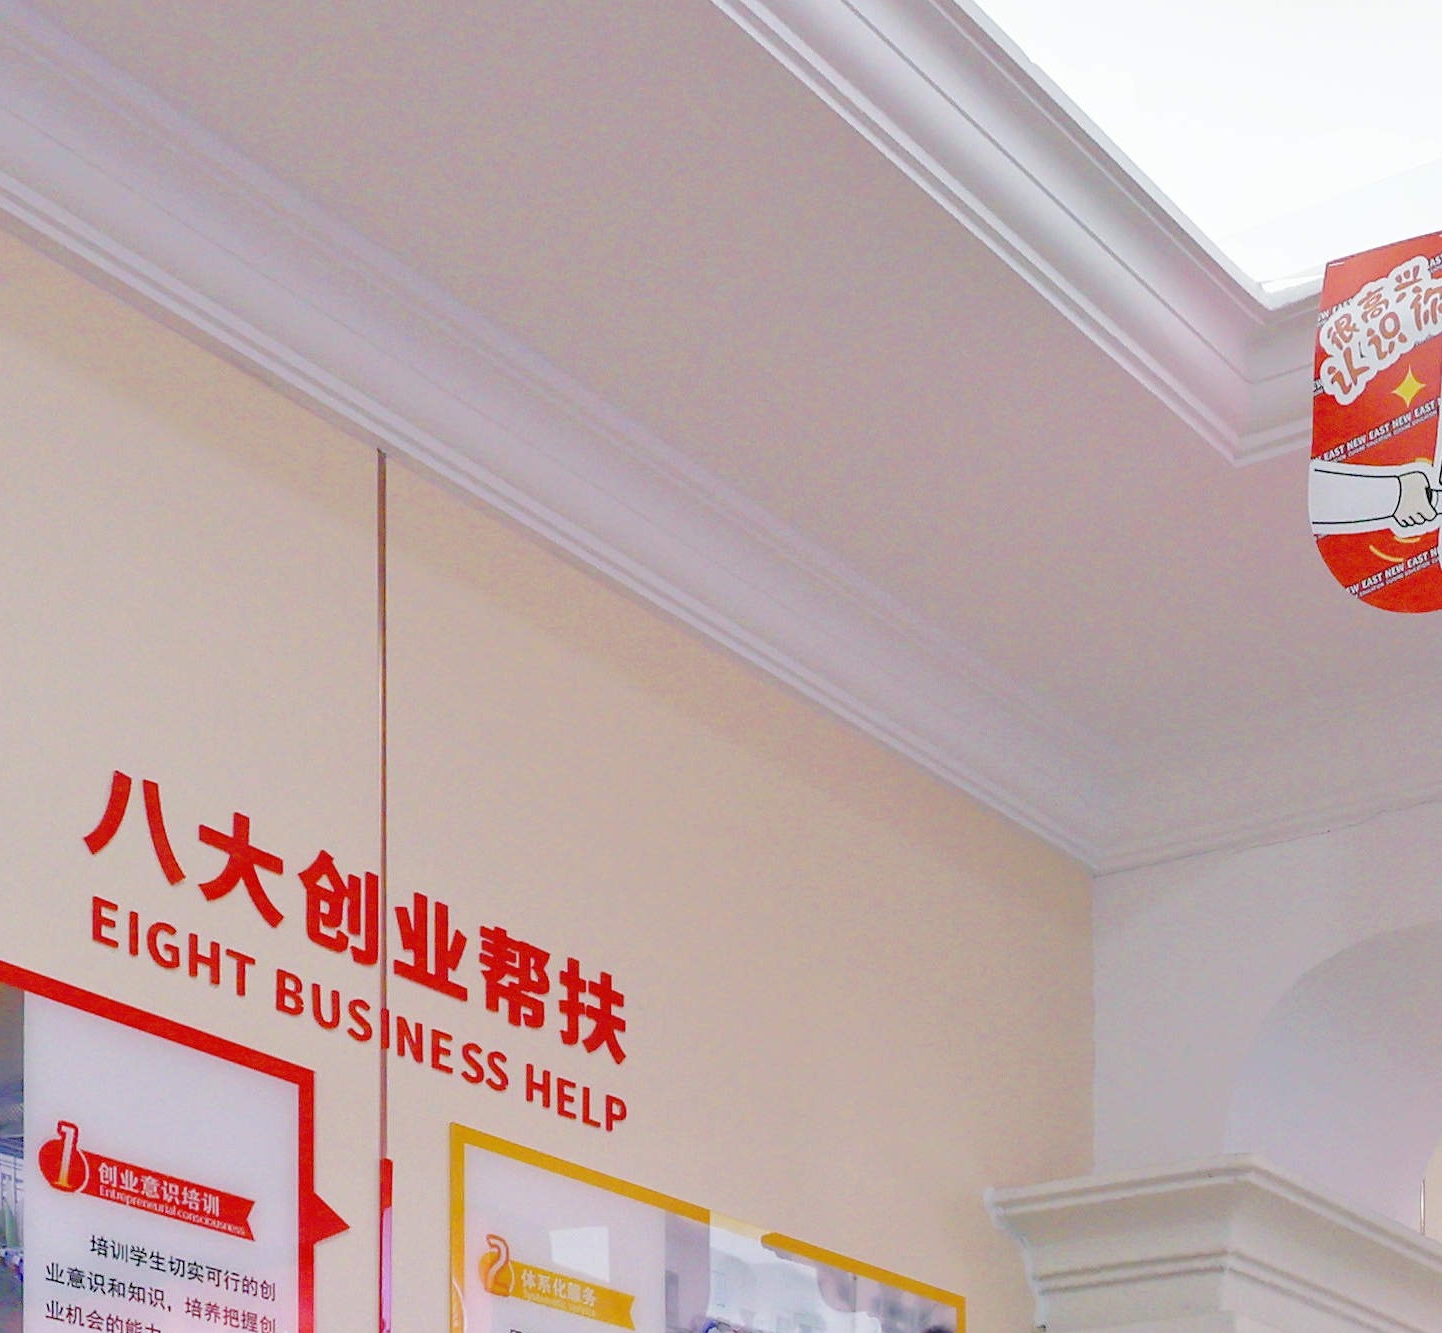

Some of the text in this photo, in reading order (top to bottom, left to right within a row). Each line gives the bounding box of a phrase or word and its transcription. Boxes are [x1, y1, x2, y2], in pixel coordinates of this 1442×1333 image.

[1327, 264, 1423, 350] 很高兴
[1323, 442, 1345, 462] EAST
[1346, 434, 1367, 451] NEW
[1368, 422, 1390, 441] EAST
[1392, 412, 1413, 429] NEW
[1414, 400, 1436, 418] EAST
[1362, 572, 1385, 591] EAST
[1385, 561, 1405, 580] NEW
[1407, 549, 1430, 568] EAST
[84, 770, 626, 1064] 八大创业帮扶
[92, 896, 628, 1132] EIGHT BUSINESS HELP
[60, 1124, 76, 1187] 1
[99, 1162, 220, 1218] 创业意识培训
[90, 1235, 276, 1302] 培训学生切实可行的创
[521, 1269, 596, 1307] 体系化服务
